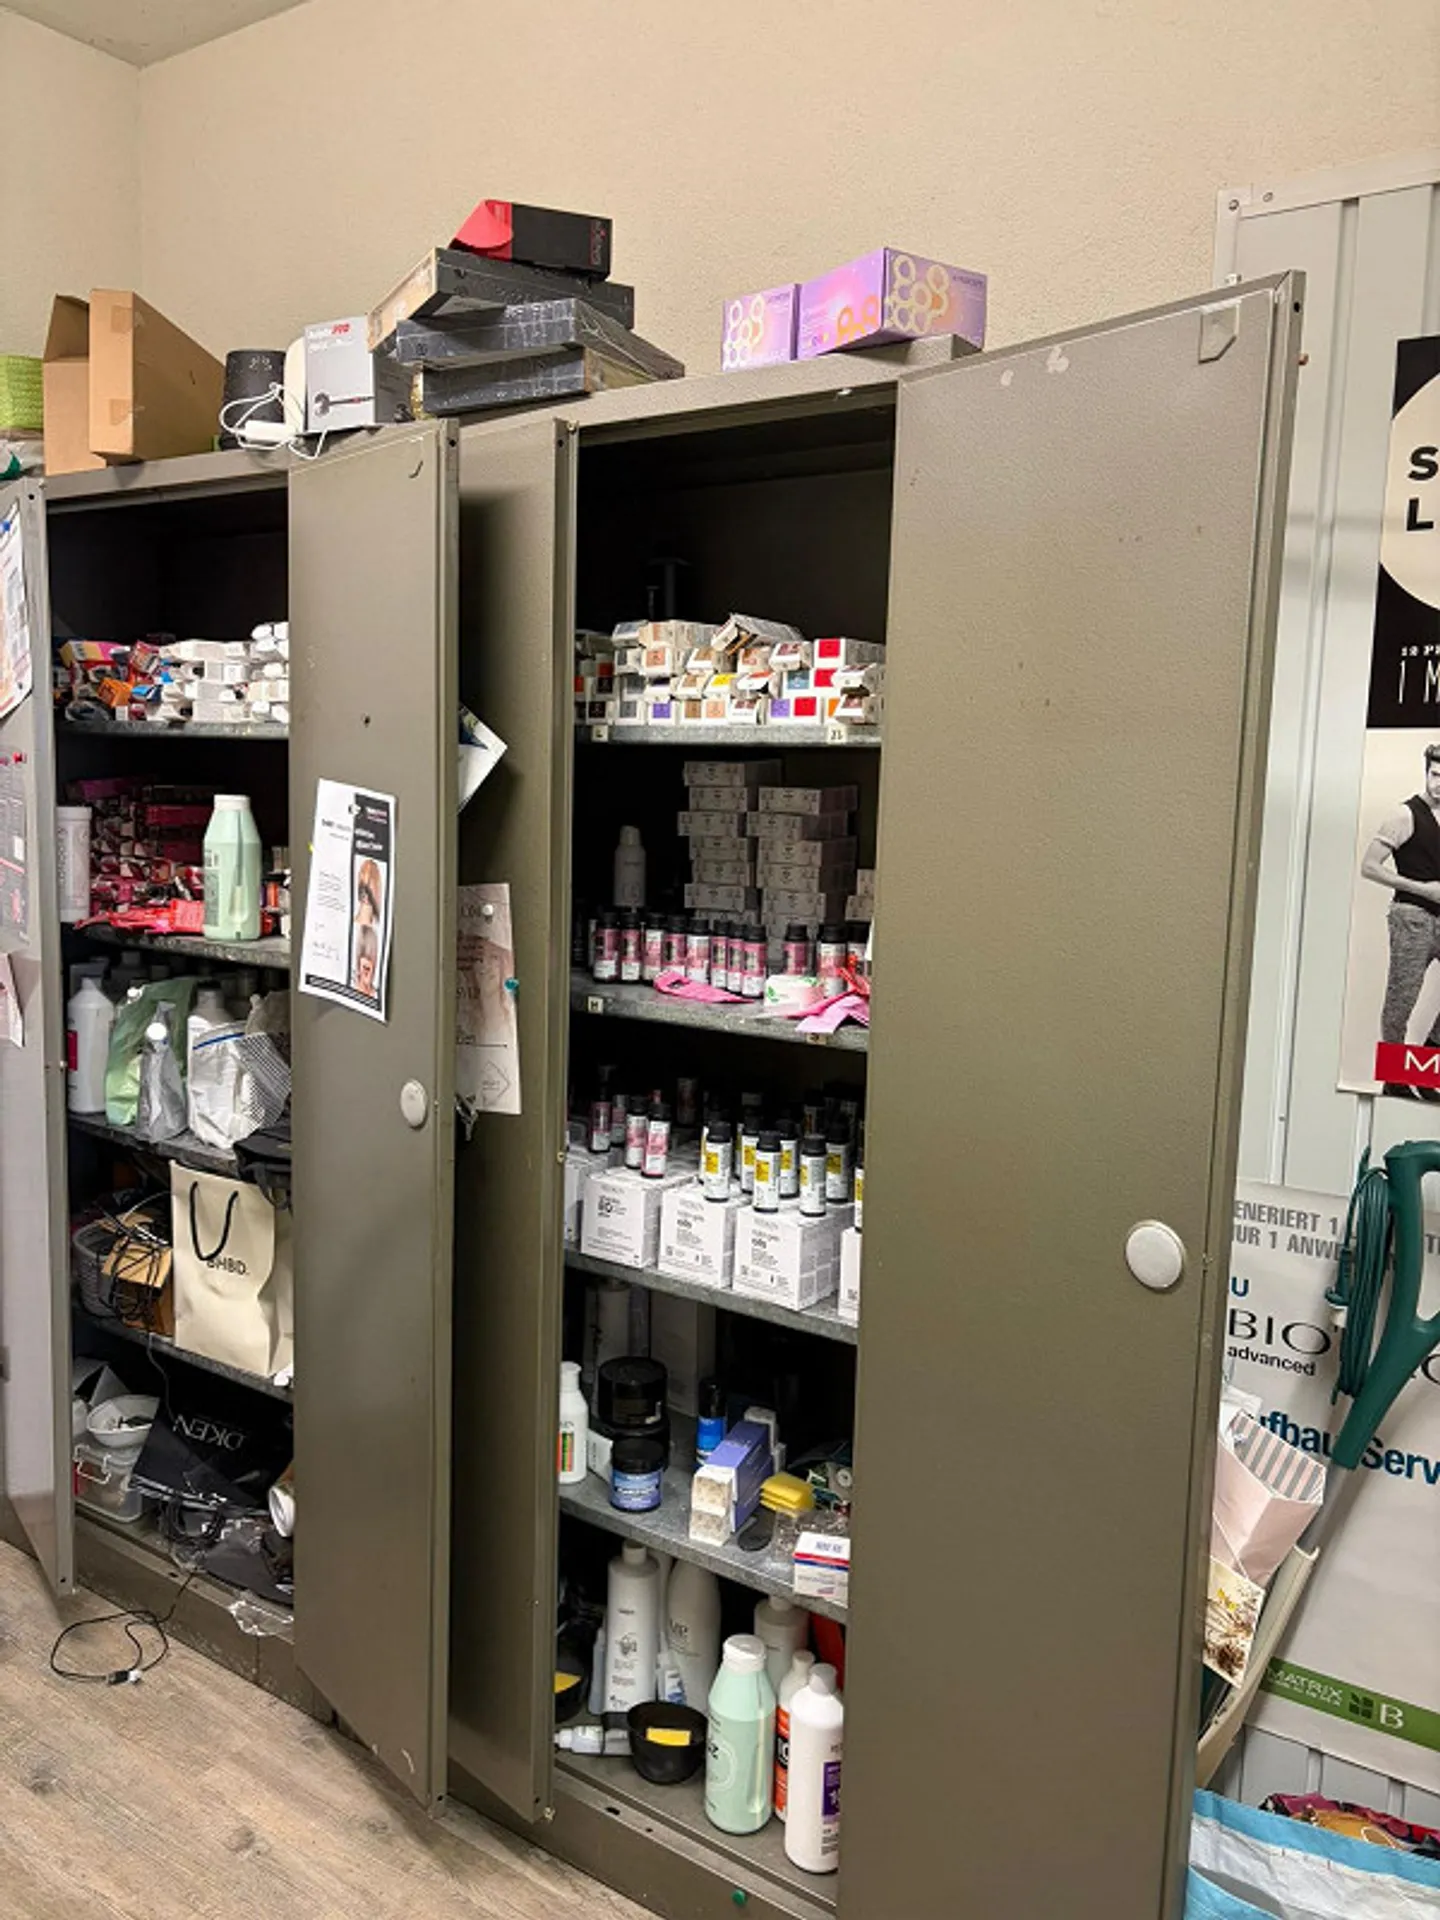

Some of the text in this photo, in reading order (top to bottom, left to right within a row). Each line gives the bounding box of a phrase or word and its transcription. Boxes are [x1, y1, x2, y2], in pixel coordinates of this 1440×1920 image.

[1406, 497, 1434, 531] L
[1229, 1308, 1337, 1355] BIO
[1227, 1346, 1316, 1377] advanced
[1380, 1702, 1404, 1730] B
